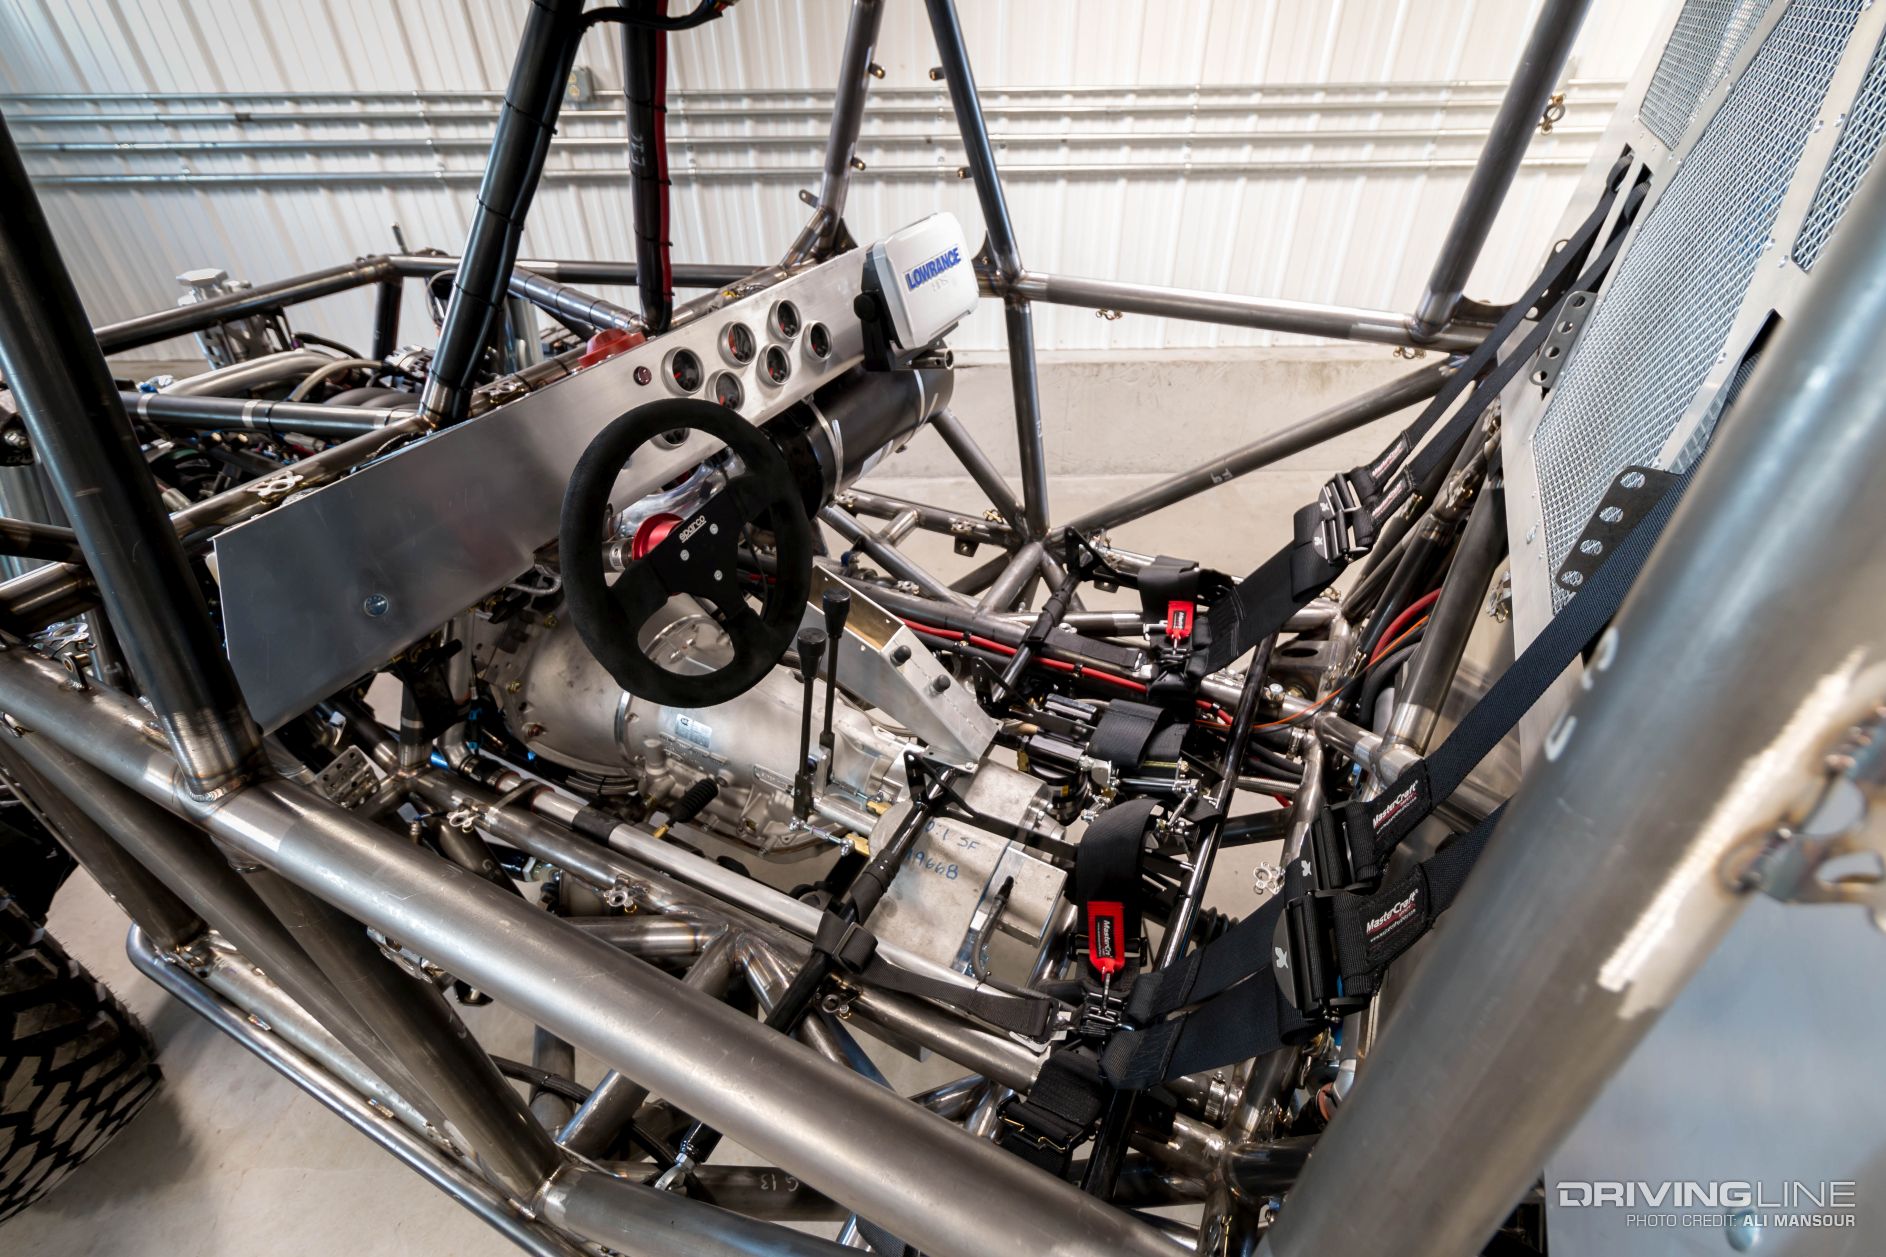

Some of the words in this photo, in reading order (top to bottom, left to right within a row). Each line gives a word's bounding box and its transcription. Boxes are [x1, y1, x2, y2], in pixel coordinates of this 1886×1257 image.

[905, 247, 961, 292] LOWRANCE
[679, 515, 706, 542] sparco
[1372, 783, 1417, 829] MasterCraft
[1366, 889, 1418, 934] MasterCraft
